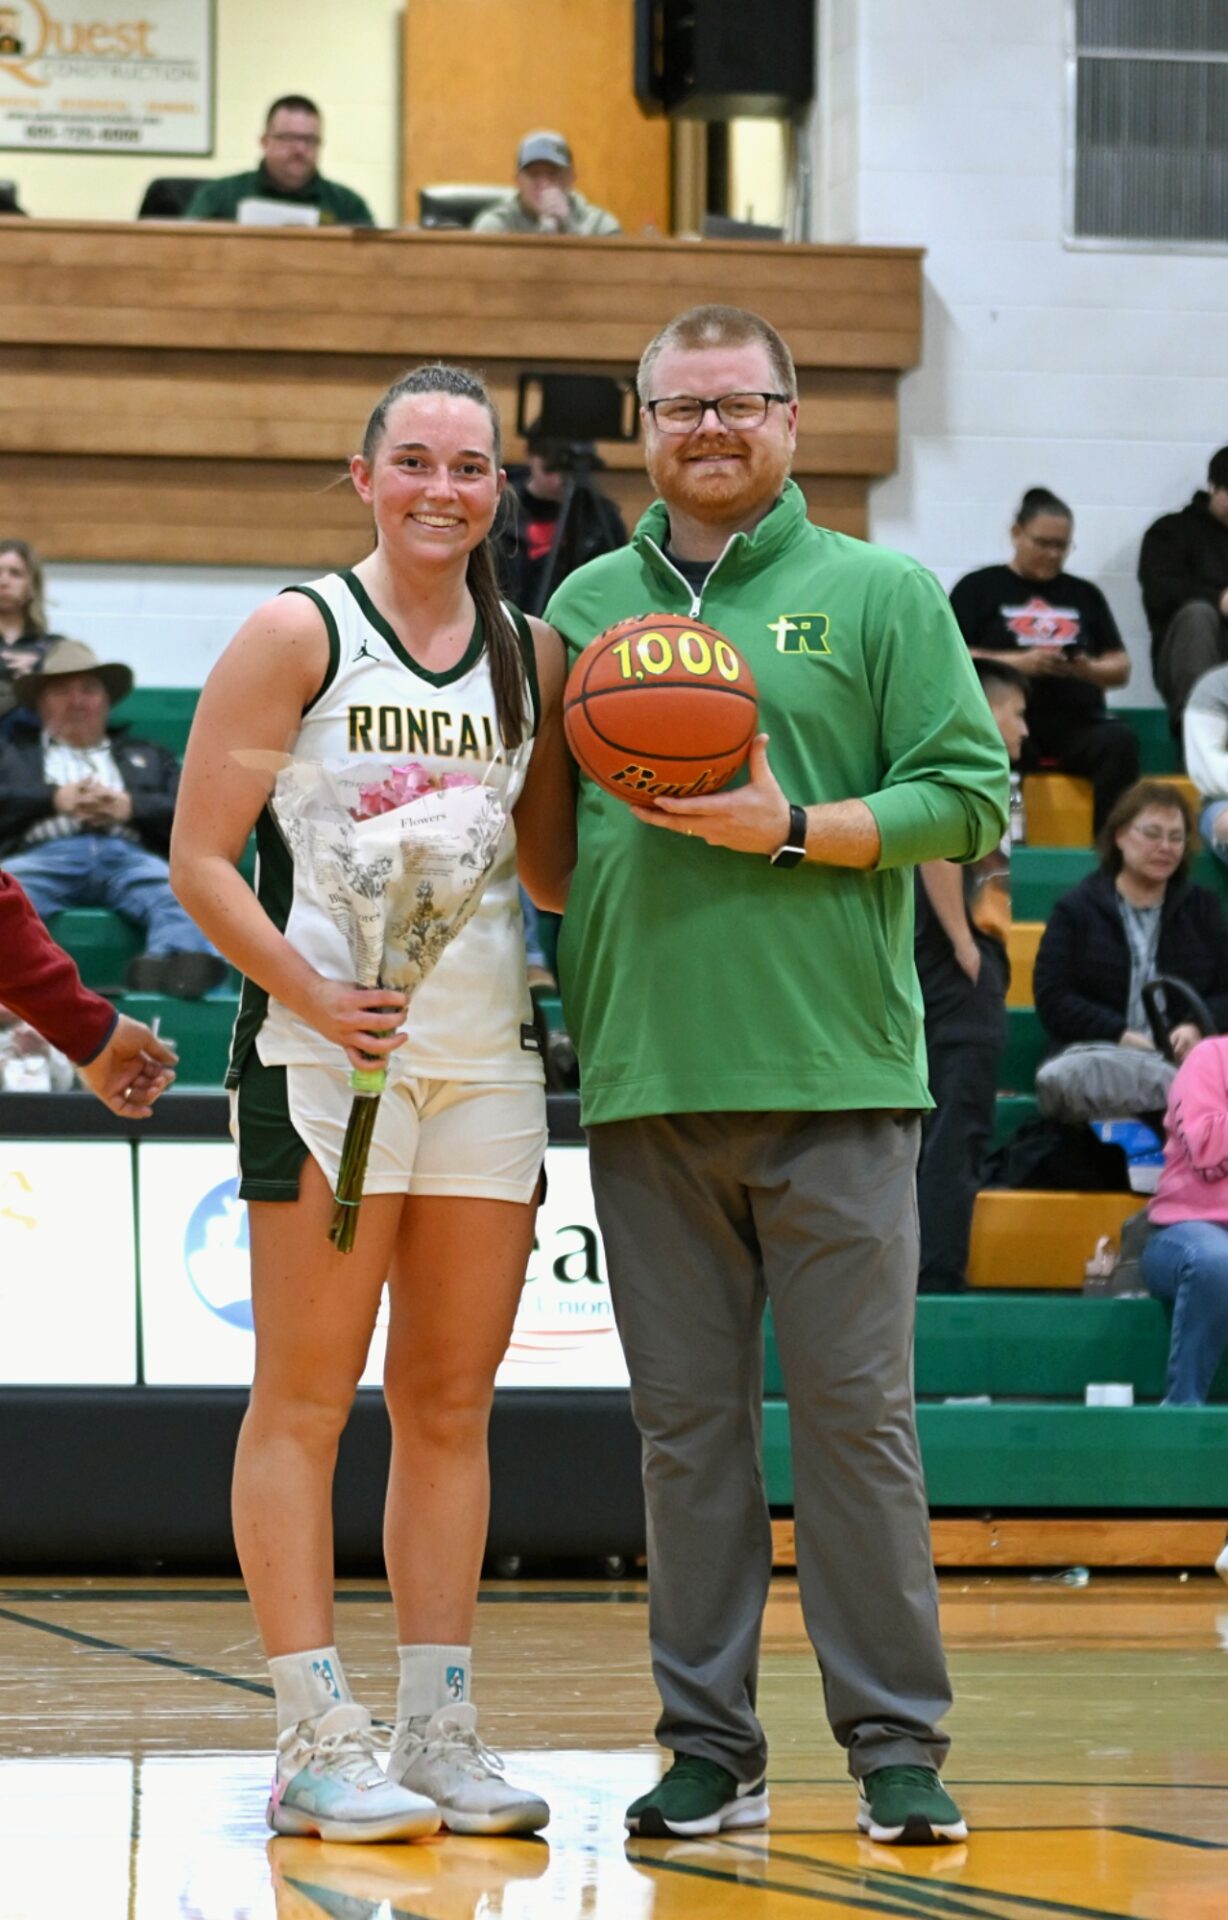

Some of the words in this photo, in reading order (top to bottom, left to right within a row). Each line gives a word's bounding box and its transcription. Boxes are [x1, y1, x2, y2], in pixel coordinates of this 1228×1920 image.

[612, 630, 740, 682] 1,000
[348, 705, 513, 767] RONCAL
[400, 813, 447, 828] Flowers
